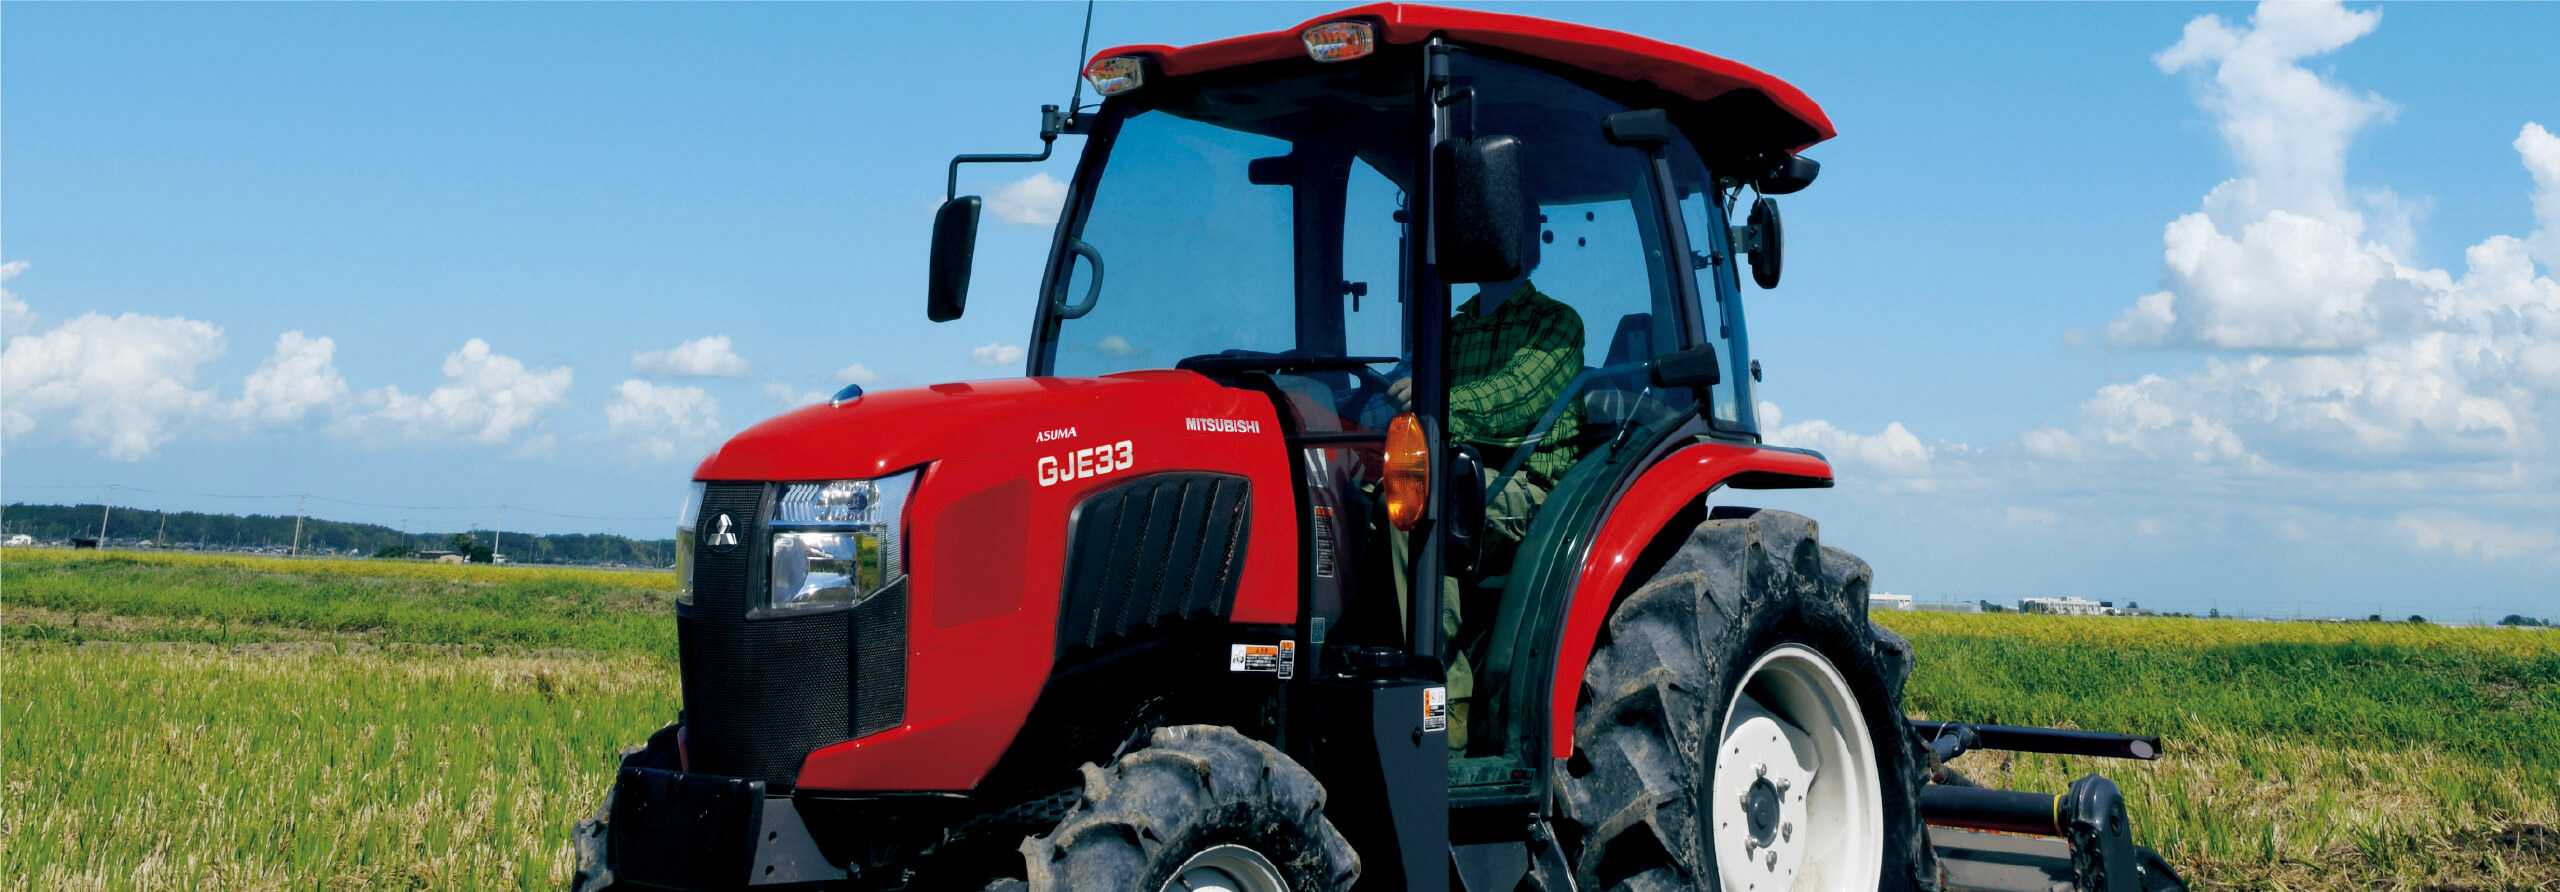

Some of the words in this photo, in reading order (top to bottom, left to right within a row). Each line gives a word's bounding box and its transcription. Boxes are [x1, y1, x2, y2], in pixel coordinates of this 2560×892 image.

[1185, 417, 1261, 434] MITSUBISHI
[1036, 427, 1077, 443] ASUMA
[1038, 440, 1133, 487] GJE33
